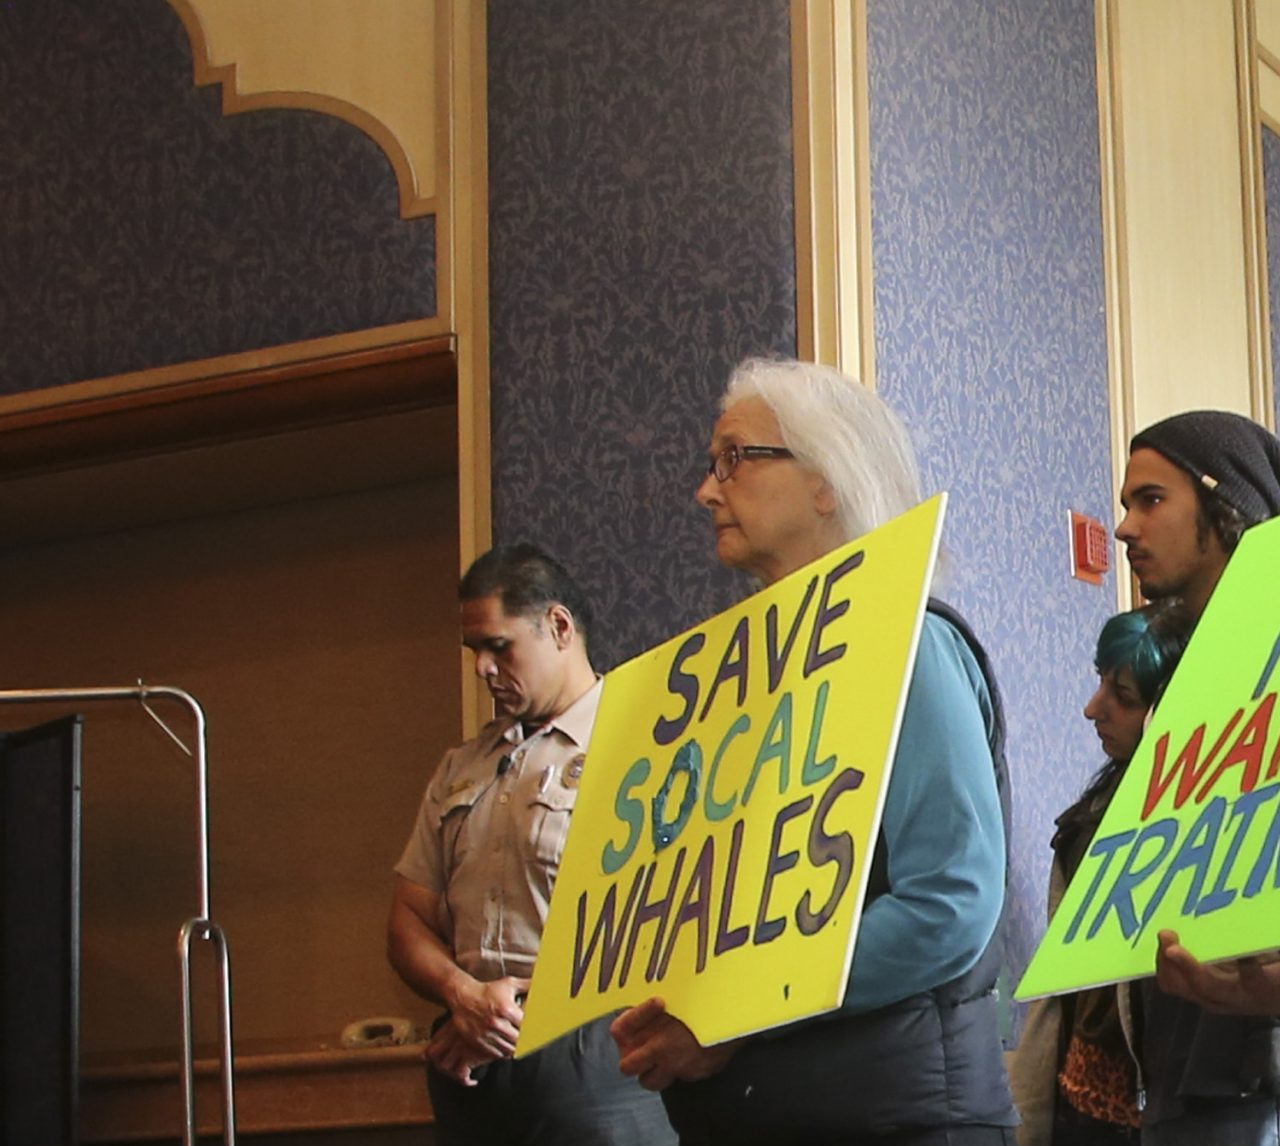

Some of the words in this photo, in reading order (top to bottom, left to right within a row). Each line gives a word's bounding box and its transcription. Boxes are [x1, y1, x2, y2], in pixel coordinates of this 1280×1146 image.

[653, 550, 864, 746] SAVE
[601, 680, 837, 875] SOCAL
[570, 768, 865, 998] WHALES
